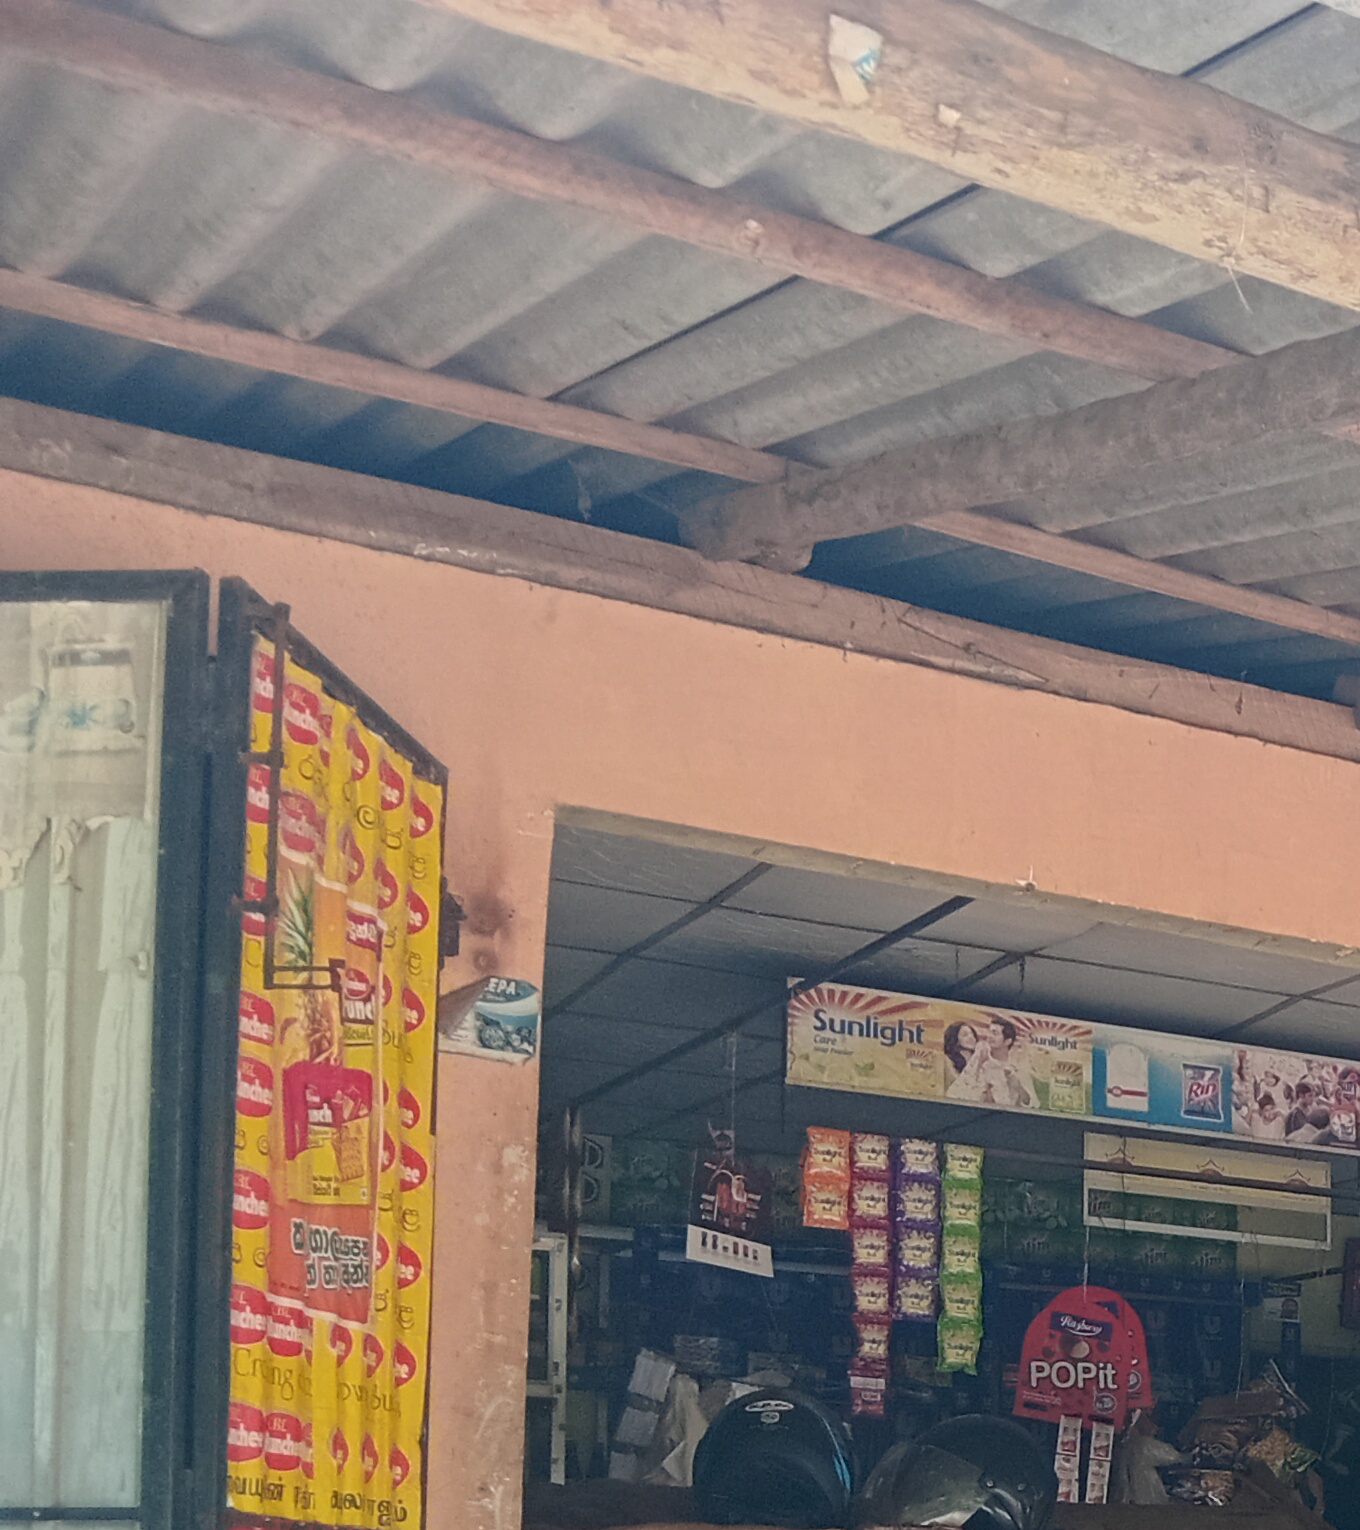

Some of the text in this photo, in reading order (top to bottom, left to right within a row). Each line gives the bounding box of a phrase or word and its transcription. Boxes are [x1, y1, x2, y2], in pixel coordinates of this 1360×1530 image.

[812, 1007, 926, 1047] Sunlight
[1027, 1031, 1078, 1051] Sunlight
[1188, 1082, 1217, 1099] Rin
[1030, 1360, 1119, 1391] POPit
